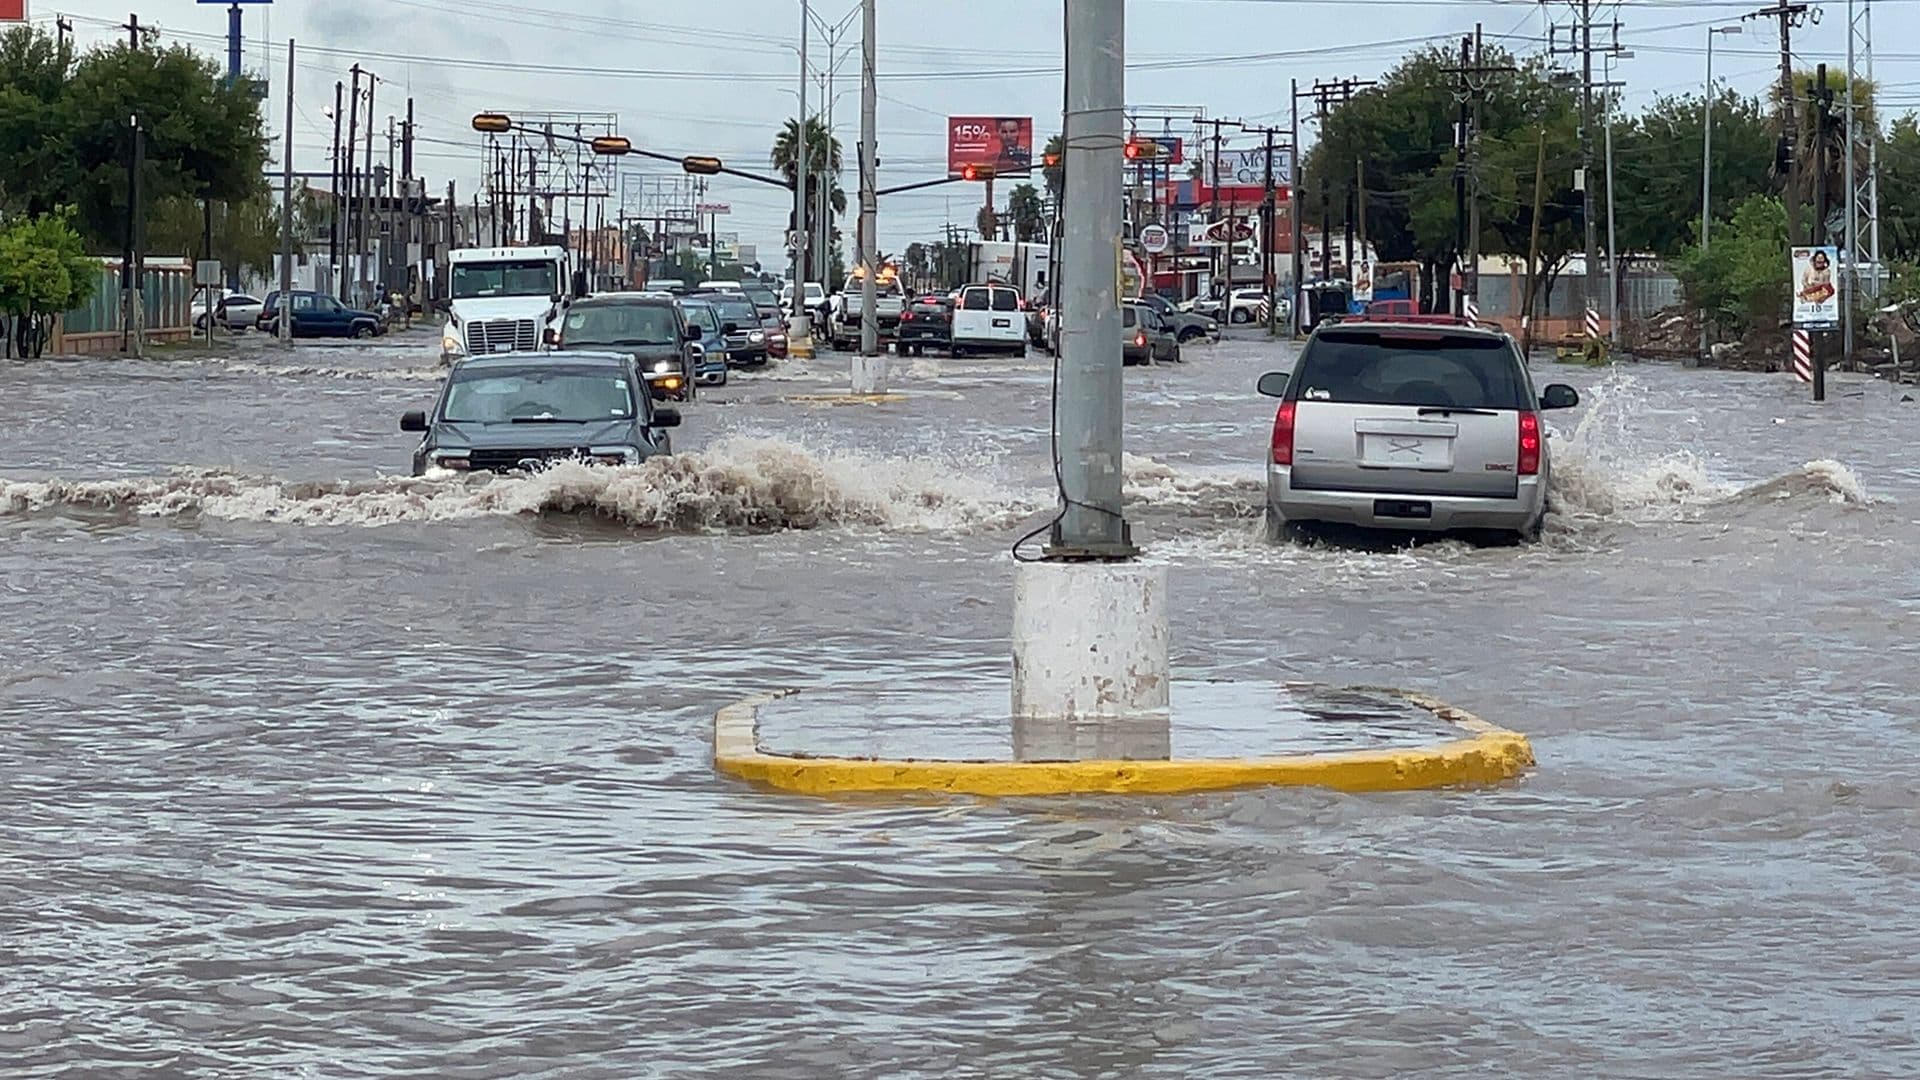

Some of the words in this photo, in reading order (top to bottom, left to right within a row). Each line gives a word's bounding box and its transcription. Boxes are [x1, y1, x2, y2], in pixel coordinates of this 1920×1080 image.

[954, 125, 991, 141] 15%
[1240, 152, 1287, 168] MOEL
[1237, 168, 1291, 184] CRN
